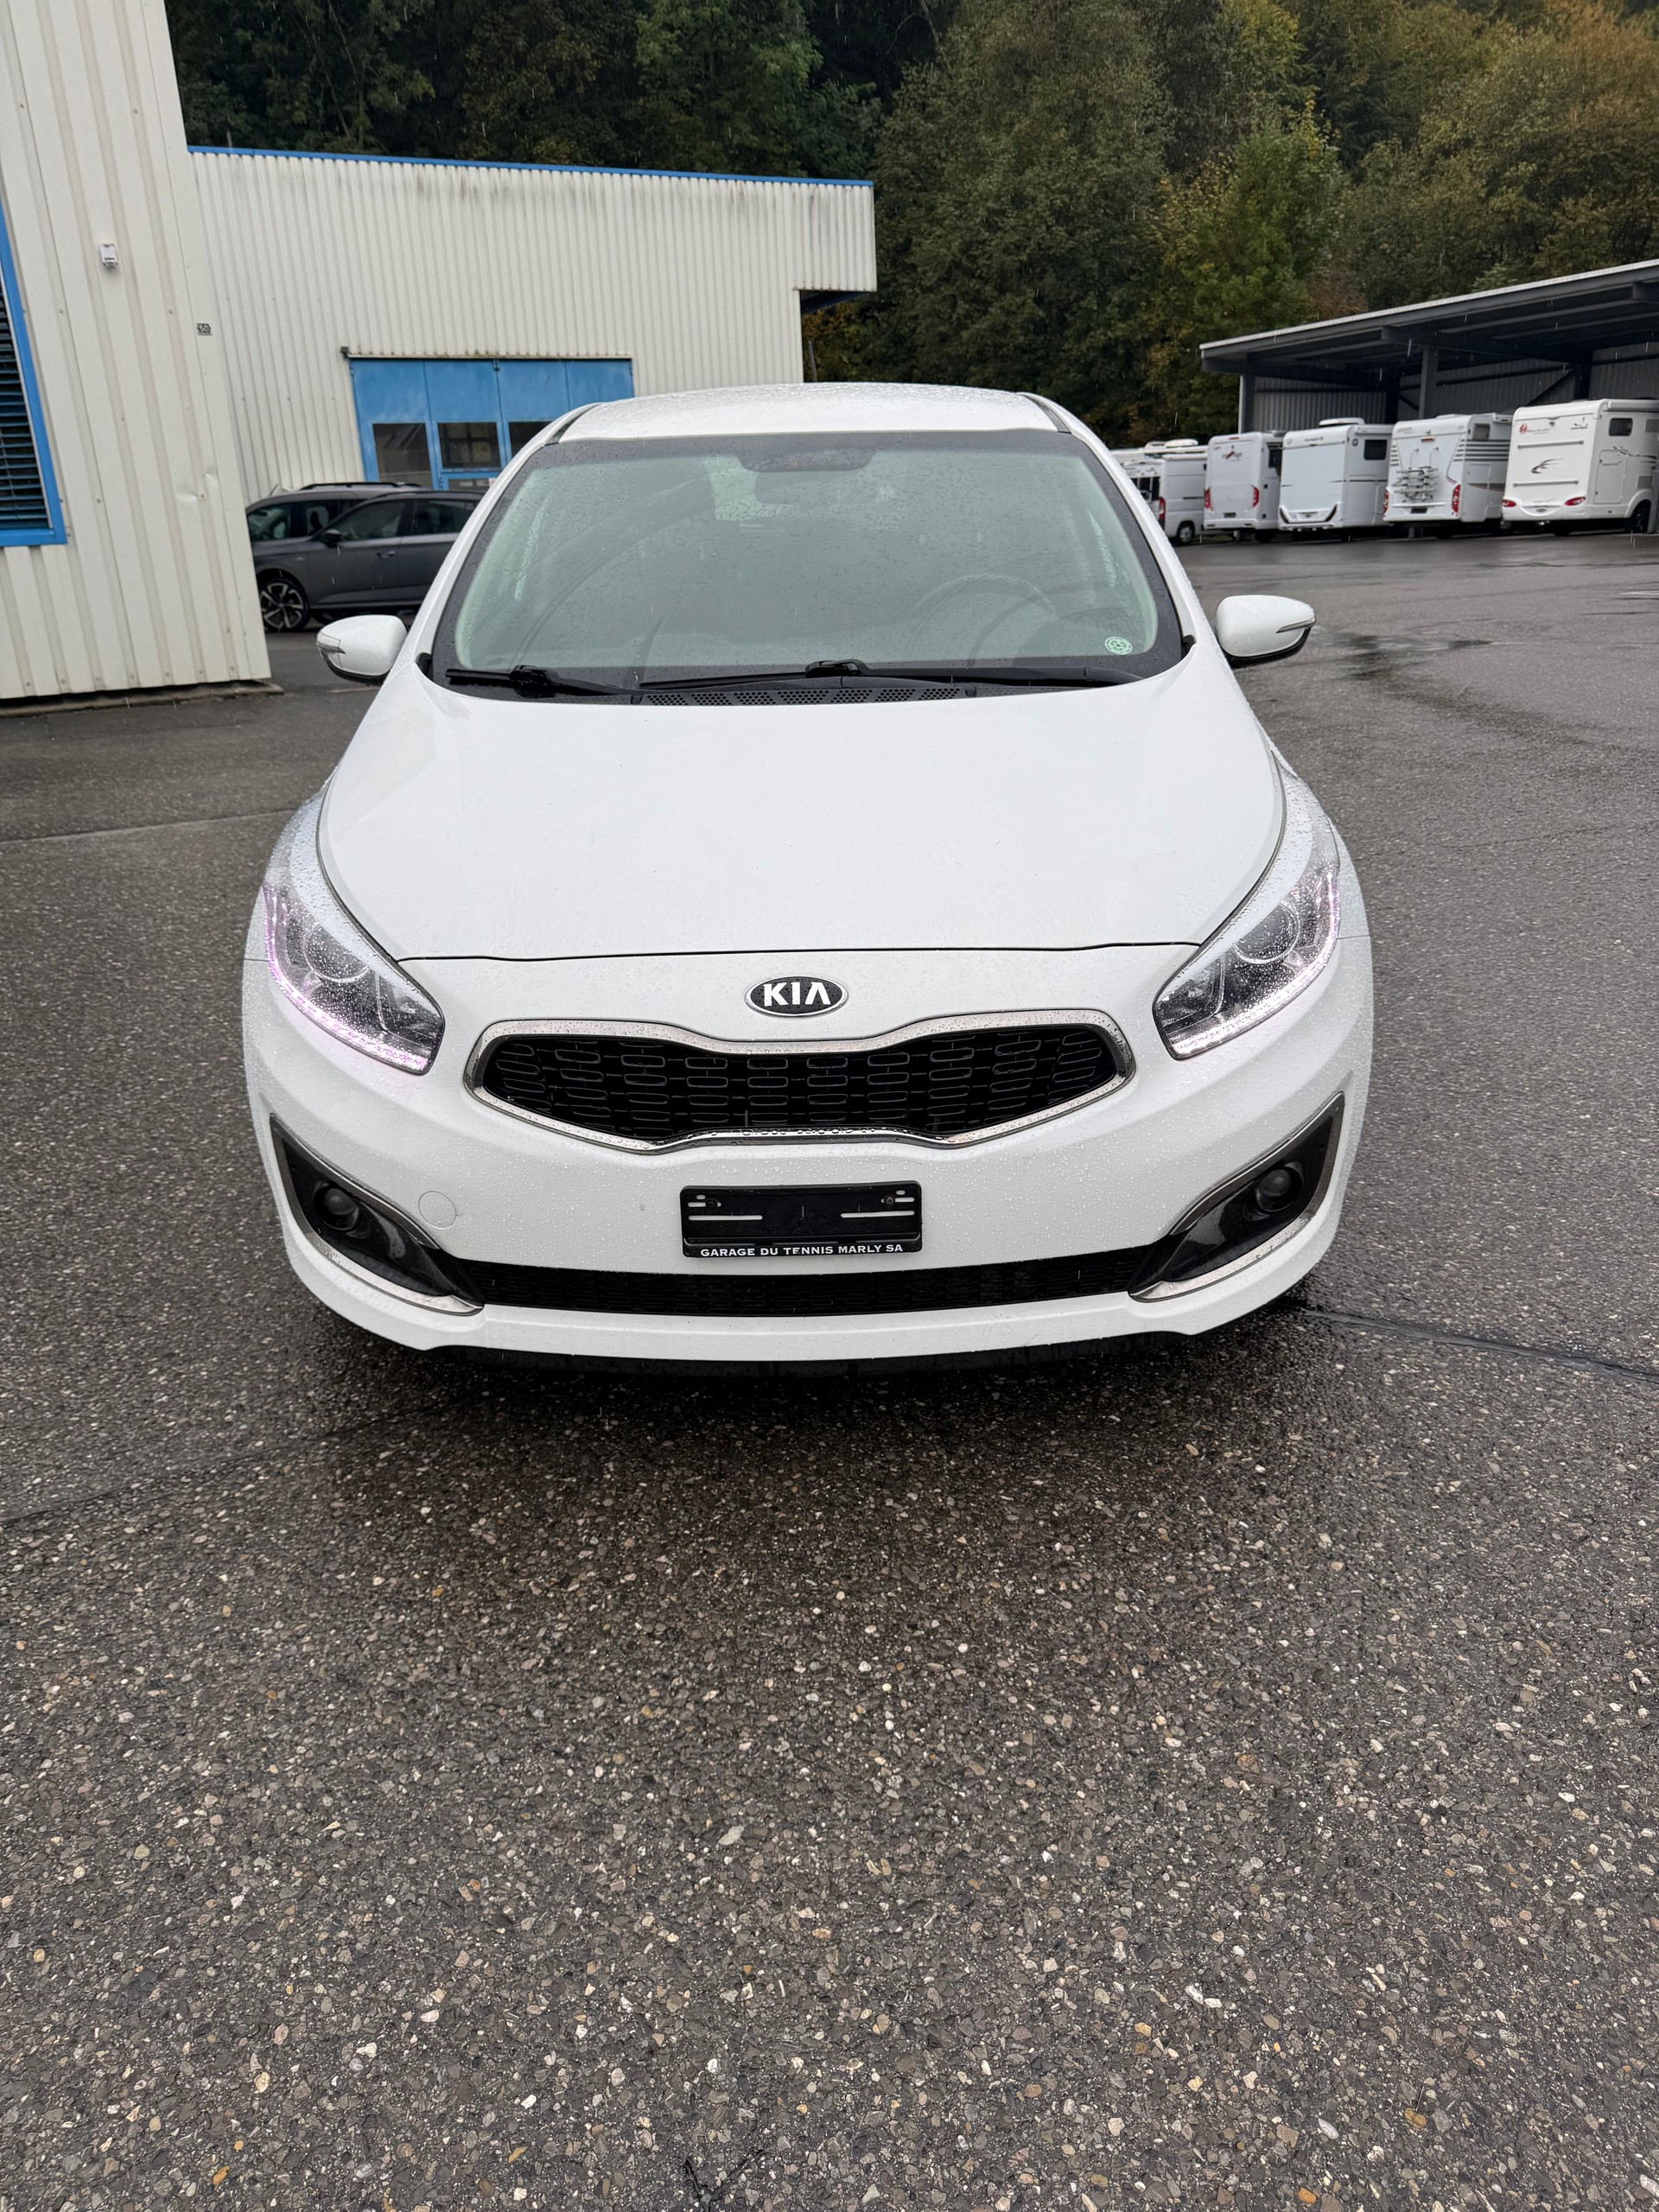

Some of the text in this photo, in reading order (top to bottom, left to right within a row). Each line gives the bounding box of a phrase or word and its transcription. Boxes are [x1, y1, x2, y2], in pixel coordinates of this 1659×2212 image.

[763, 982, 831, 1007] KIA
[700, 1243, 903, 1257] GARAGE DU TENNIS MARLY SA
